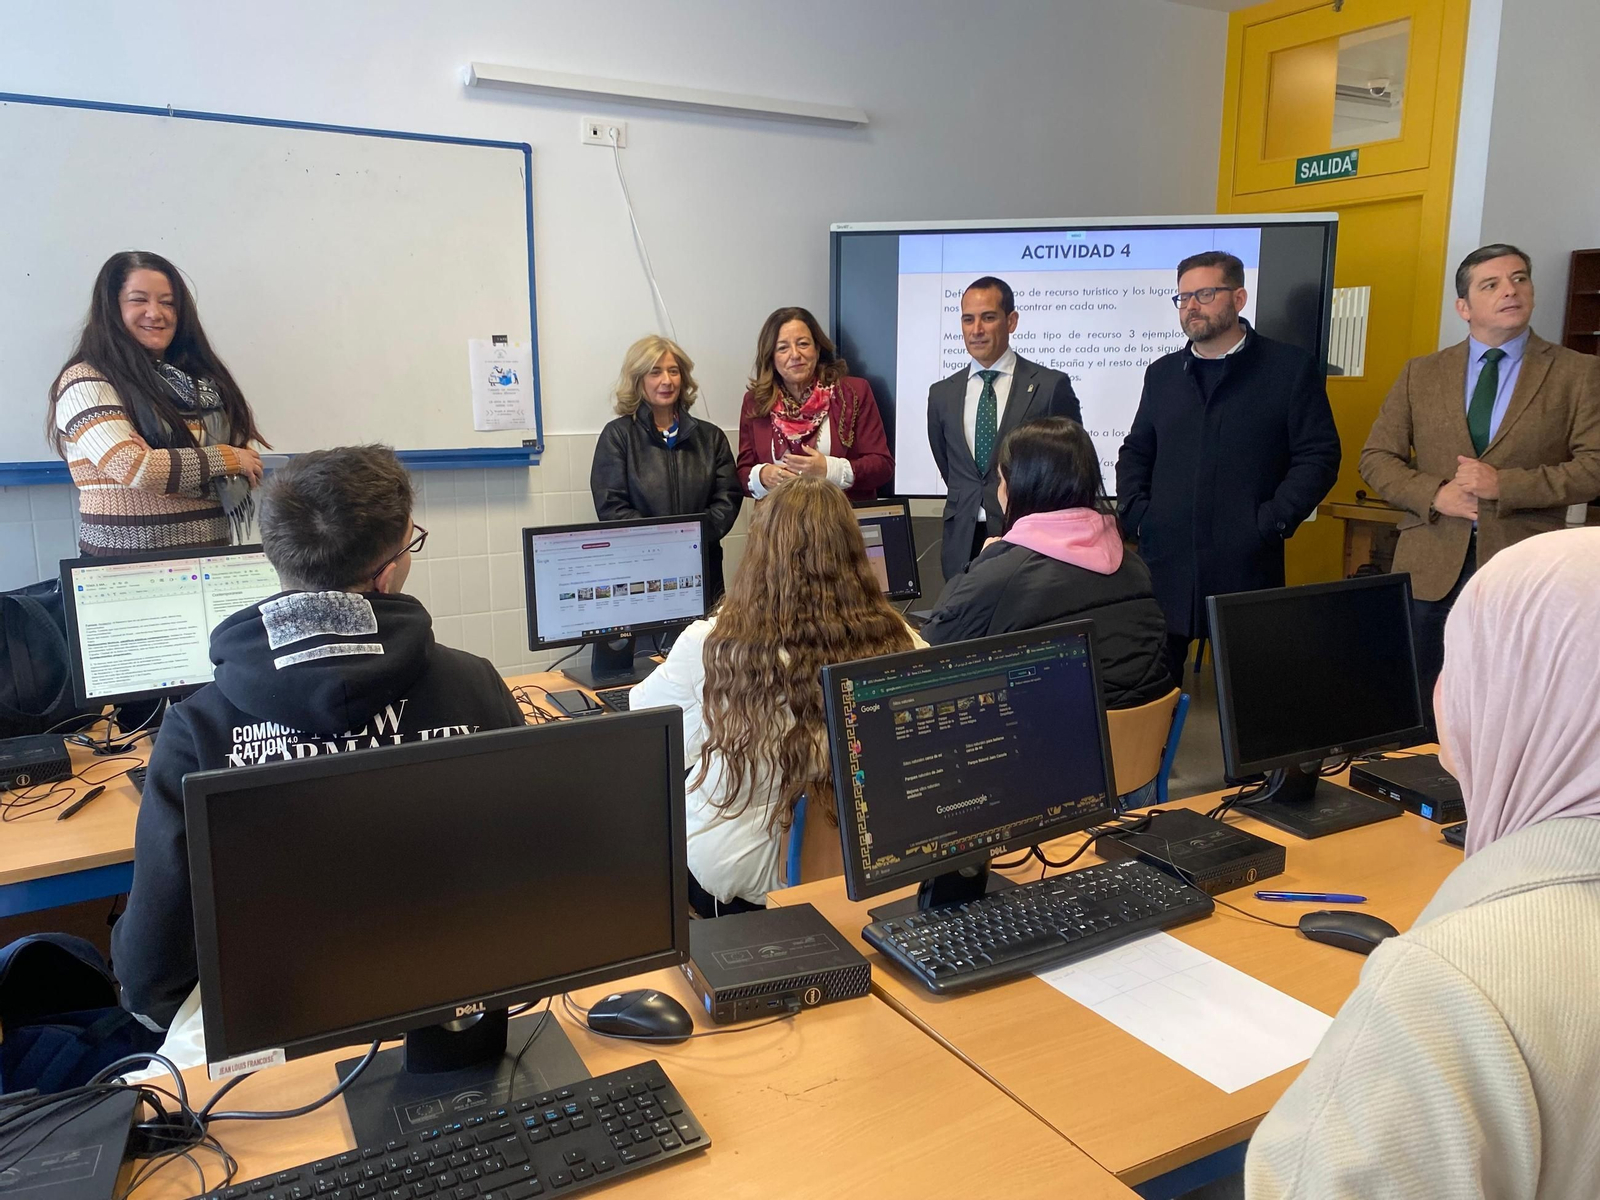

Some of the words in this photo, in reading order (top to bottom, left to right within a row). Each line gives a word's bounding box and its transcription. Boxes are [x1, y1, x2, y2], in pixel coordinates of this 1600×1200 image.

[1300, 155, 1352, 178] SALIDA
[1021, 244, 1115, 259] ACTIVIDAD
[1120, 243, 1131, 258] 4
[1029, 288, 1041, 297] de
[1045, 289, 1079, 297] recurso
[1083, 286, 1119, 296] turístico
[1122, 288, 1129, 298] y
[1132, 286, 1145, 295] los
[1149, 286, 1179, 297] lugare
[944, 305, 960, 313] nos
[1014, 303, 1052, 311] ncontrar
[1070, 302, 1094, 311] cada
[1097, 303, 1118, 311] uno.
[1012, 330, 1037, 340] cada
[1043, 331, 1062, 342] tipo
[1068, 330, 1081, 339] de
[1087, 330, 1123, 339] recurso
[1129, 329, 1136, 339] 3
[1142, 329, 1185, 340] ejemplos
[1038, 346, 1056, 354] uno
[1059, 345, 1072, 353] de
[1075, 344, 1100, 353] cada
[1103, 345, 1121, 353] uno
[1124, 344, 1137, 353] de
[1140, 343, 1154, 353] los
[942, 359, 967, 370] lugar
[1050, 358, 1085, 369] España
[1088, 360, 1094, 369] y
[1097, 358, 1106, 367] el
[1109, 359, 1133, 367] resto
[1112, 428, 1125, 437] los
[861, 703, 880, 713] Google
[232, 721, 305, 743] COMMU
[232, 735, 289, 760] CATION
[287, 735, 299, 744] 4.0
[990, 845, 1008, 857] DELL
[456, 1002, 486, 1018] DELL
[219, 1065, 232, 1076] JEAN
[232, 1061, 247, 1072] LOUIS
